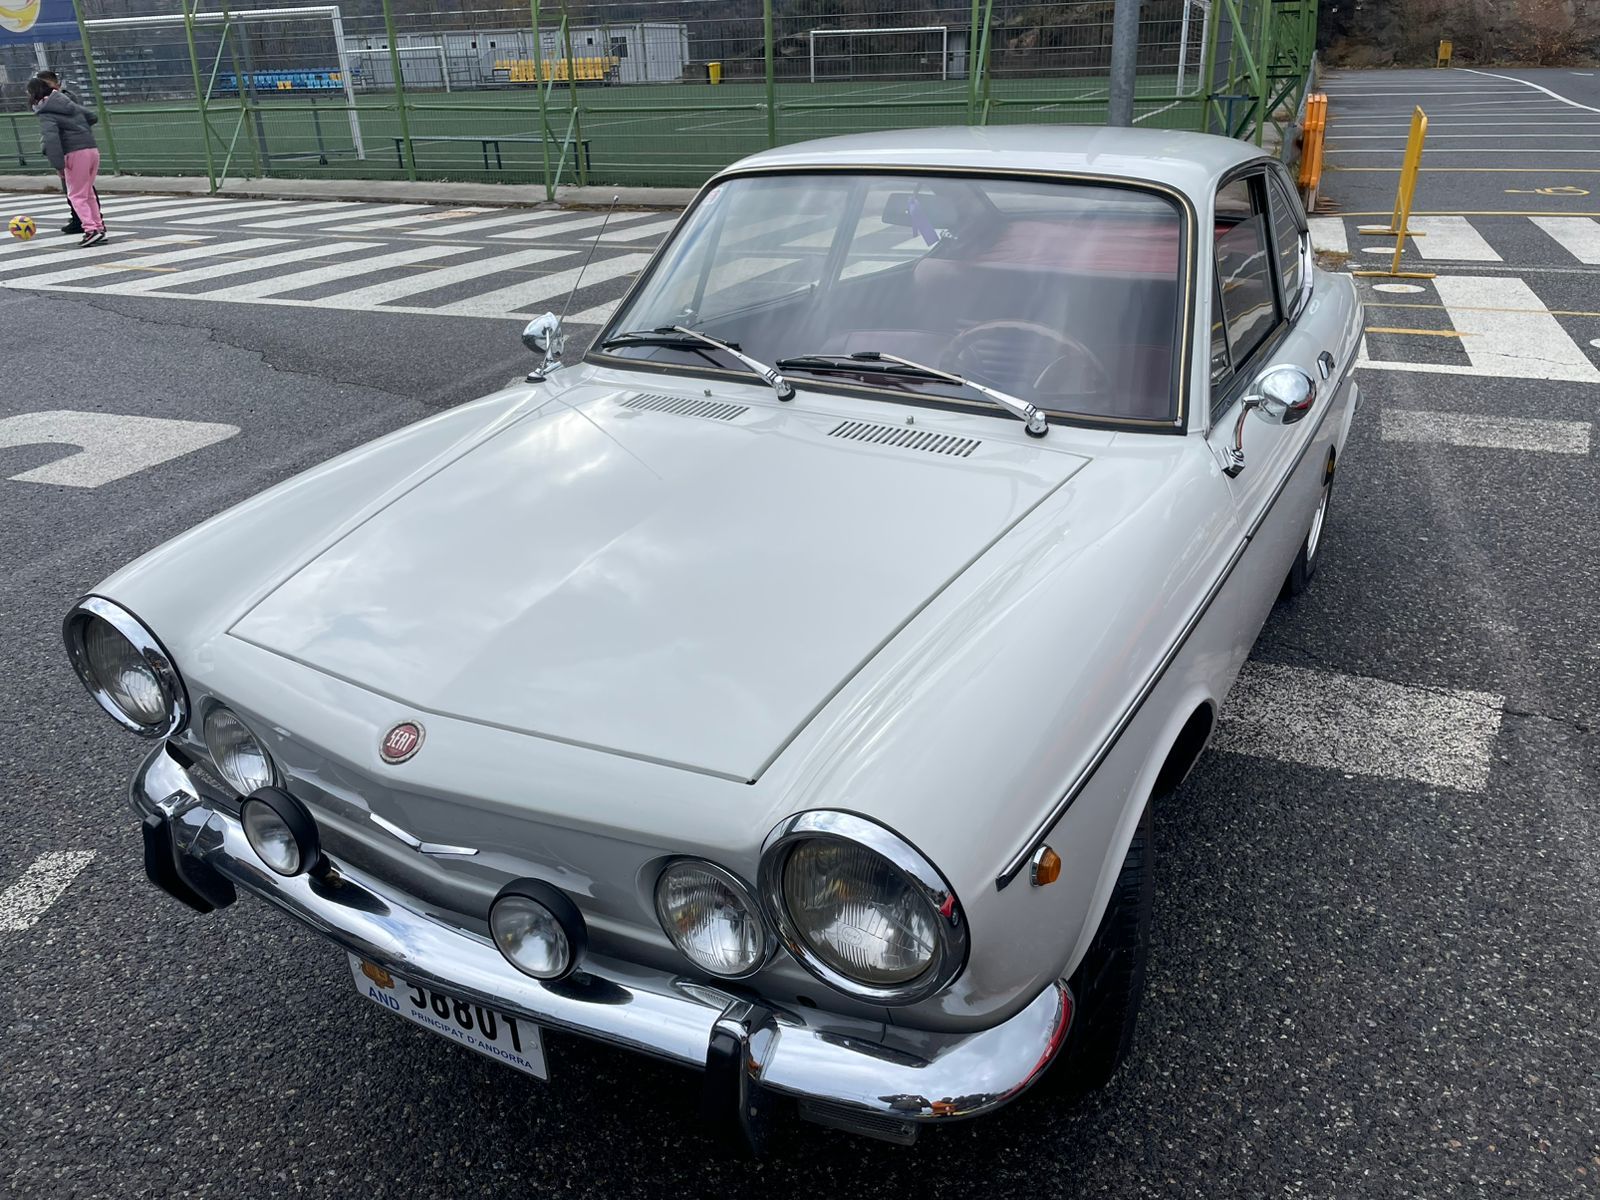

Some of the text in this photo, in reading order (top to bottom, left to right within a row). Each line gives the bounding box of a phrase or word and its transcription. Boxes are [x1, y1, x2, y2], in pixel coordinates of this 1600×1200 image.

[369, 986, 400, 1010] AND
[411, 1008, 533, 1070] PRINCIPAT D'ANDORRA
